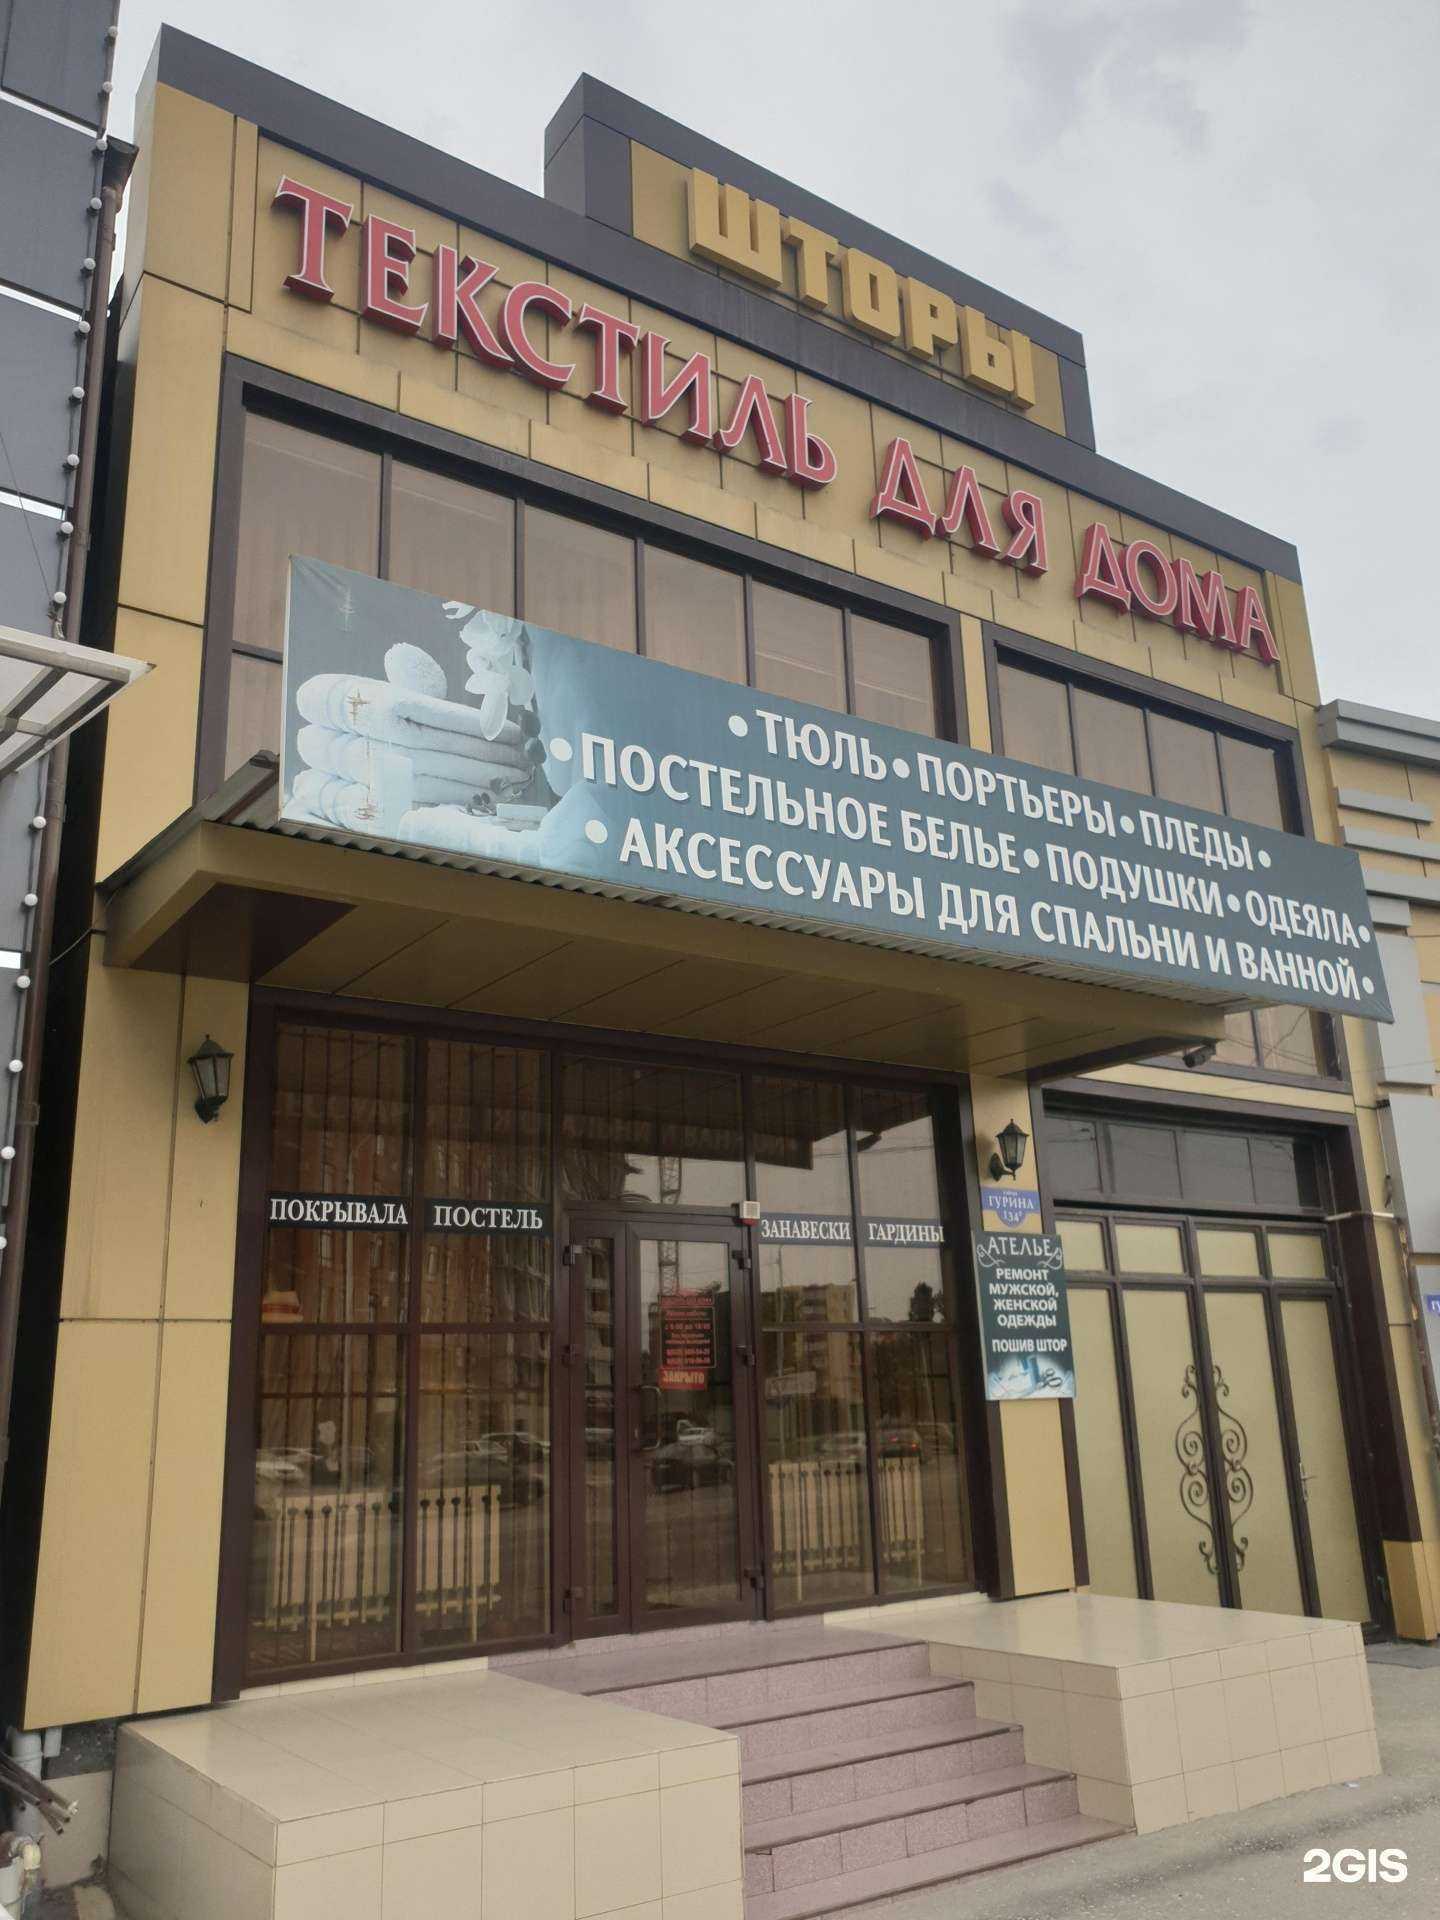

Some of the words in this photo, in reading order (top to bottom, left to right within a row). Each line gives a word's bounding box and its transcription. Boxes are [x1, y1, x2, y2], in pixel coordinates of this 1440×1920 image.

[687, 168, 1036, 410] ШТОРЫ
[272, 174, 838, 490] ТЕКСТИЛЬ
[869, 437, 1049, 577] ДЛЯ
[1075, 522, 1280, 666] ДОМА
[755, 709, 887, 781] ТЮЛЬ
[916, 752, 1116, 837] ПОРТЬЕРЫ
[1139, 809, 1254, 872] ПЛЕДЫ
[581, 732, 892, 847] ПОСТЕЛЬНОЕ
[900, 810, 1021, 874] БЕЛЬЕ
[1045, 843, 1224, 918] ПОДУШКИ
[1245, 889, 1360, 948] ОДЕЯЛА
[619, 817, 926, 919] АКСЕССУАРЫ
[937, 881, 1020, 937] ДЛЯ
[1030, 900, 1200, 970] СПАЛЬНИ
[1205, 934, 1232, 976] И
[1236, 942, 1361, 1001] ВАННОЙ
[269, 1198, 409, 1225] ПОКРЫВАЛА
[433, 1205, 543, 1230] ПОСТЕЛЬ
[988, 1195, 1034, 1209] ГУРИНА
[760, 1218, 851, 1240] ЗАНАВЕСКИ
[868, 1222, 945, 1245] ГАРДИНЫ
[987, 1236, 1053, 1257] АТЕЛЬЕ
[996, 1267, 1049, 1281] РЕМОНТ
[989, 1282, 1059, 1298] МУЖСКОЙ,
[993, 1298, 1058, 1312] ЖЕНСКОЙ
[997, 1314, 1057, 1329] ОДЕЖДЫ
[991, 1338, 1034, 1353] ПОШИВ
[1036, 1338, 1067, 1352] ШТОР
